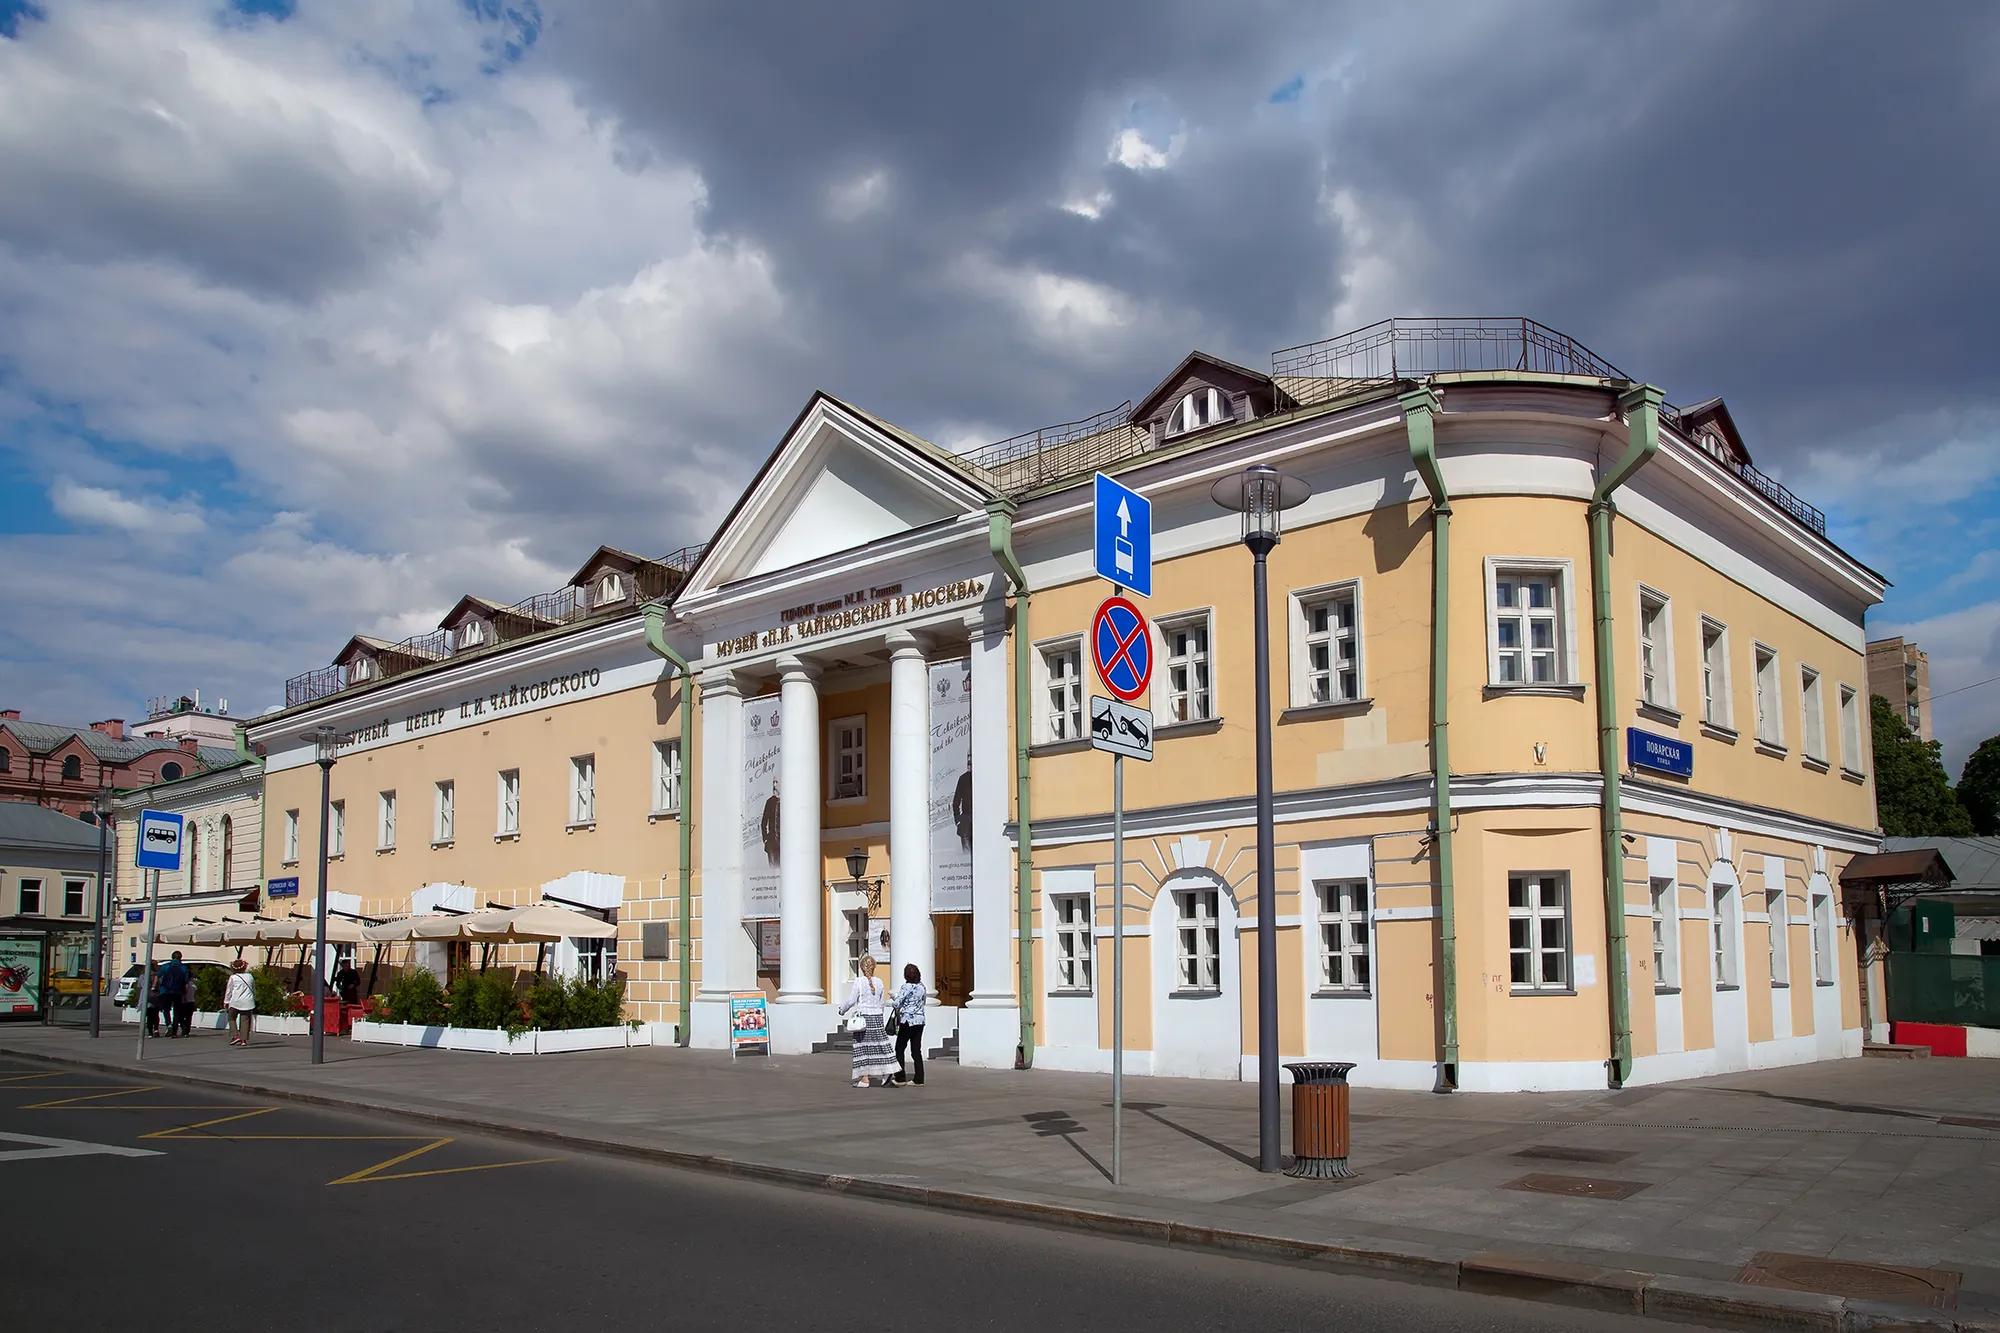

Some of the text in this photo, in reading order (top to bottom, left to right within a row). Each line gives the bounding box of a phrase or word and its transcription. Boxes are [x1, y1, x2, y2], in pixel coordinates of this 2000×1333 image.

[716, 630, 758, 658] МУЗЕЙ
[797, 599, 892, 639] ЧАЙКОВСКИЙ
[895, 597, 907, 616] И
[912, 579, 984, 612] МОСКВА»
[405, 707, 445, 733] ЦЕНТР
[490, 668, 600, 711] ЧАЙКОВСКОГО
[1646, 740, 1680, 760] ПОВАРСКАЯ
[1657, 757, 1670, 765] УЛИЦА
